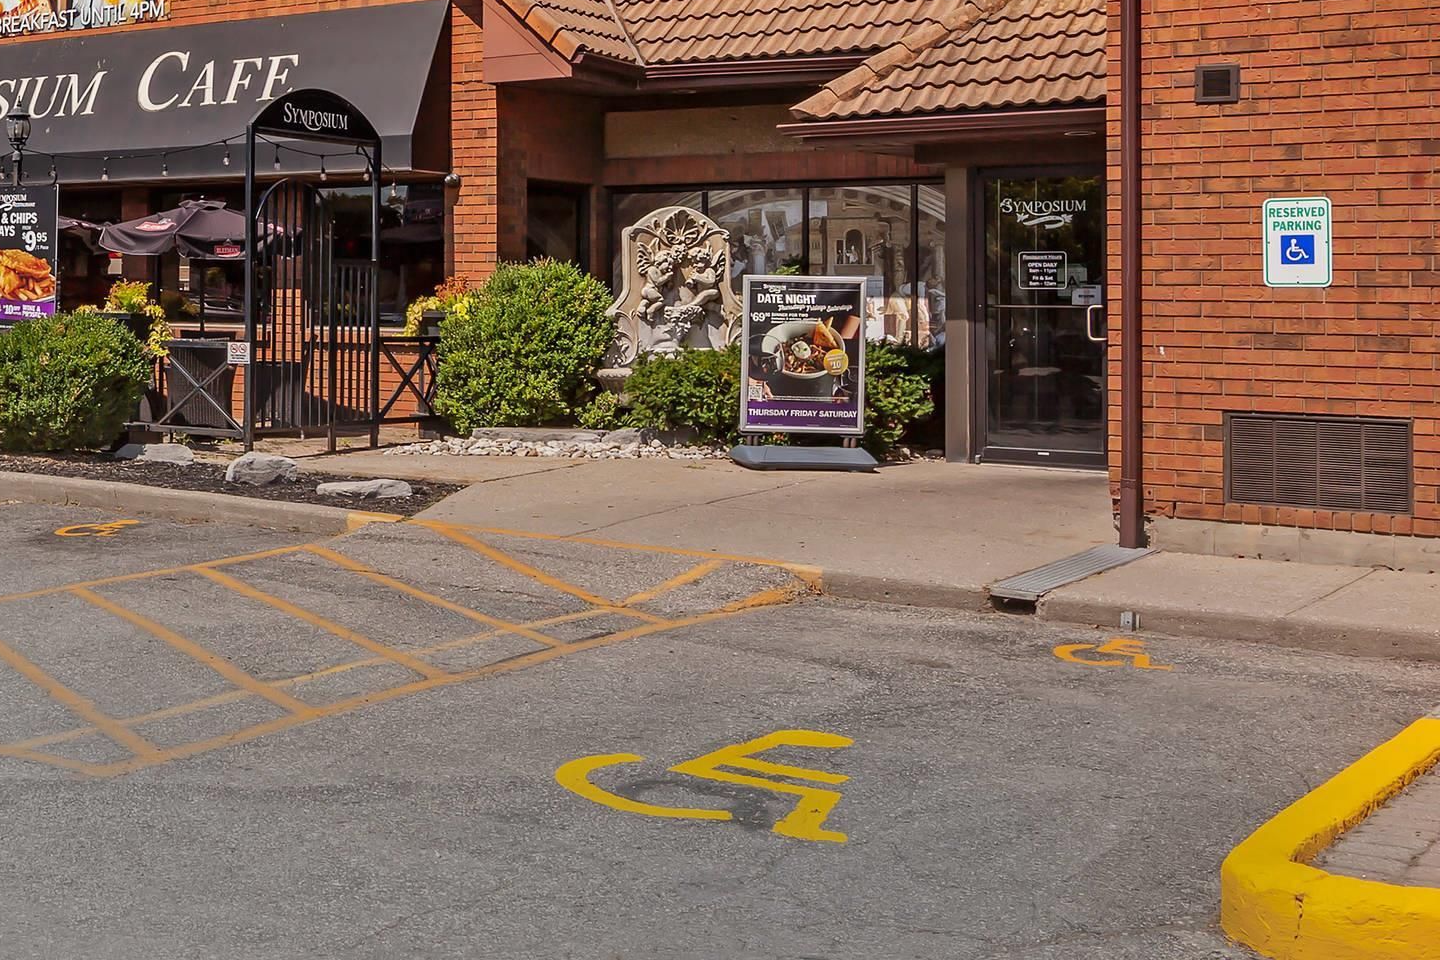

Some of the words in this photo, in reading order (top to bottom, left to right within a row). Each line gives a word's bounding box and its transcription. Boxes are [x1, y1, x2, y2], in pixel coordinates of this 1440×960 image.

[82, 4, 127, 26] UNTIL
[130, 0, 165, 20] 4PM
[137, 51, 299, 111] CAFE
[283, 102, 348, 131] SYMPOSIUM
[1000, 198, 1087, 216] SYMPOSIUM
[1269, 207, 1325, 218] RESERVED
[1, 213, 9, 224] &
[10, 212, 38, 224] CHIPS
[1273, 220, 1322, 231] PARKING
[757, 293, 783, 304] DATE
[785, 295, 817, 305] NIGHT
[748, 408, 789, 416] THURSDAY
[790, 409, 818, 417] FRIDAY
[818, 410, 858, 418] SATURDAY
